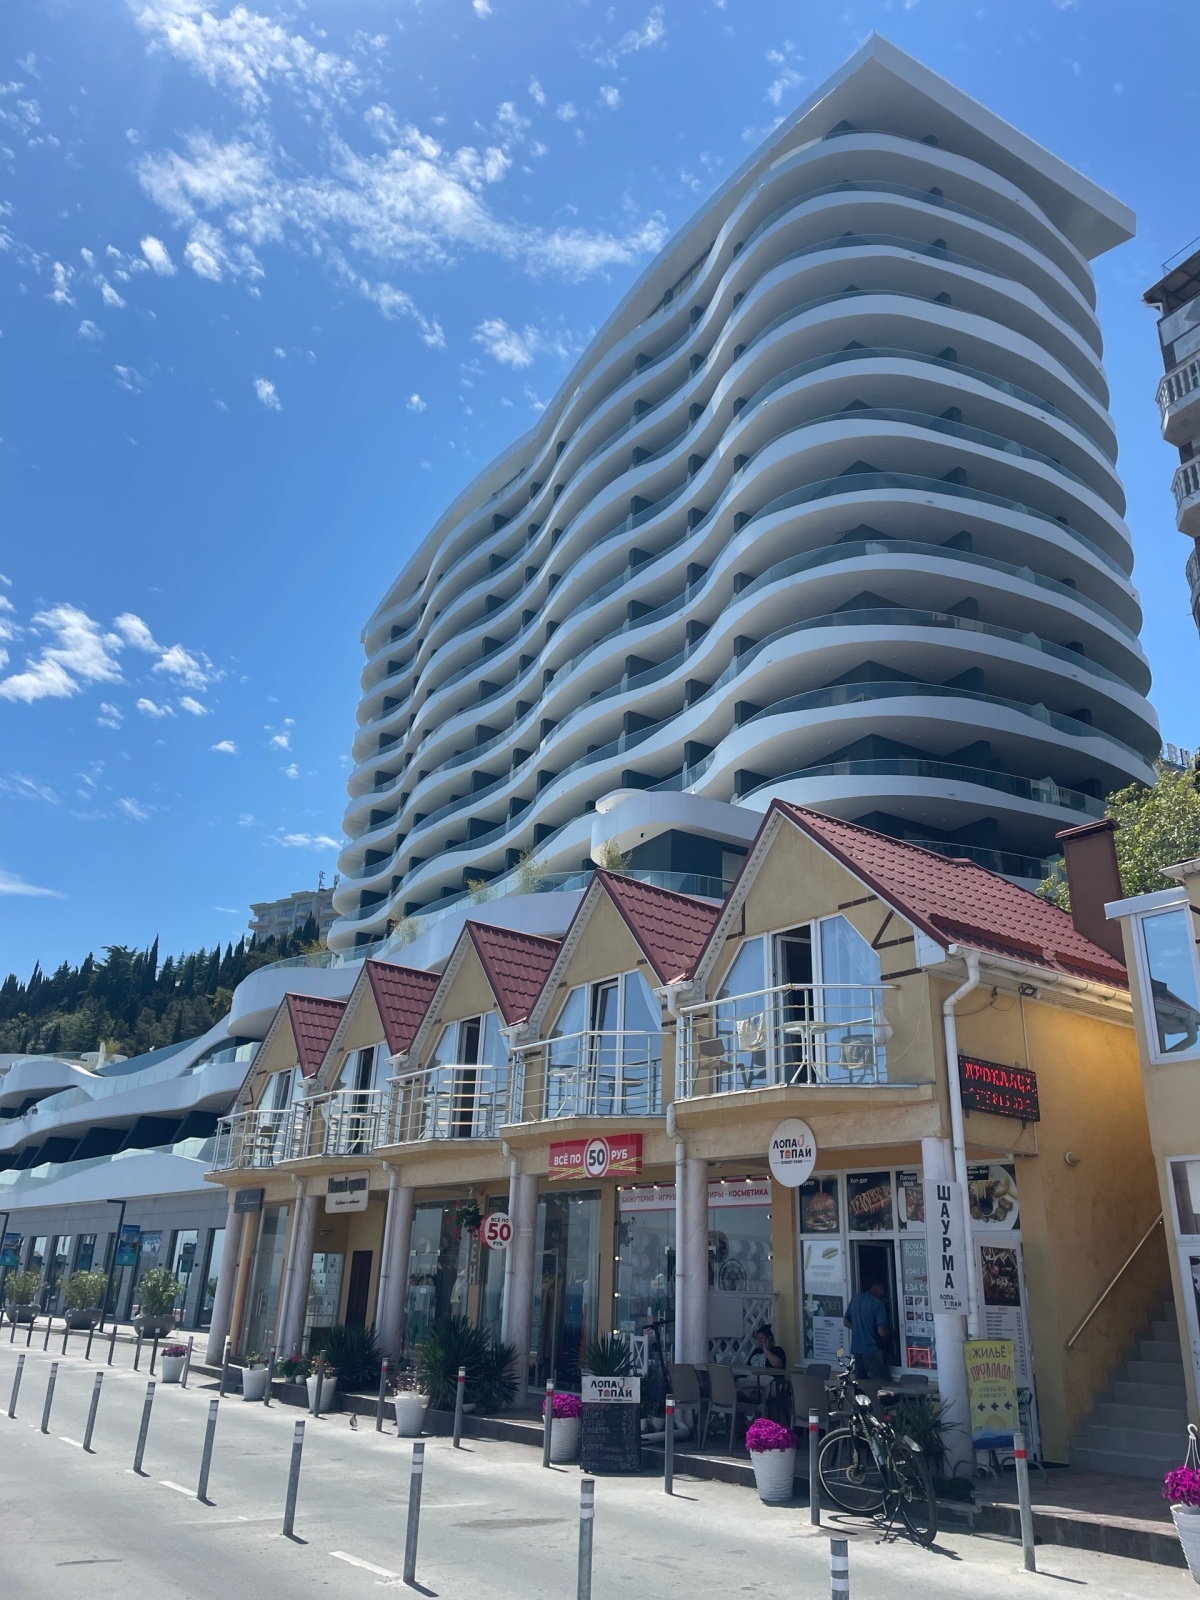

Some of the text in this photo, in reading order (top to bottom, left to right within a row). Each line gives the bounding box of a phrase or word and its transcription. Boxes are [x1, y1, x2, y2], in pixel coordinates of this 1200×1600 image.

[554, 1148, 628, 1167] ВСЁ ПО 50 РУБ
[621, 1194, 655, 1203] БИЖУТЕРИЯ
[729, 1188, 769, 1197] КОСМЕТИКА
[487, 1222, 511, 1241] 50
[936, 1184, 954, 1289] ШАУРМА
[972, 1345, 1006, 1359] ЖИЛЬЁ
